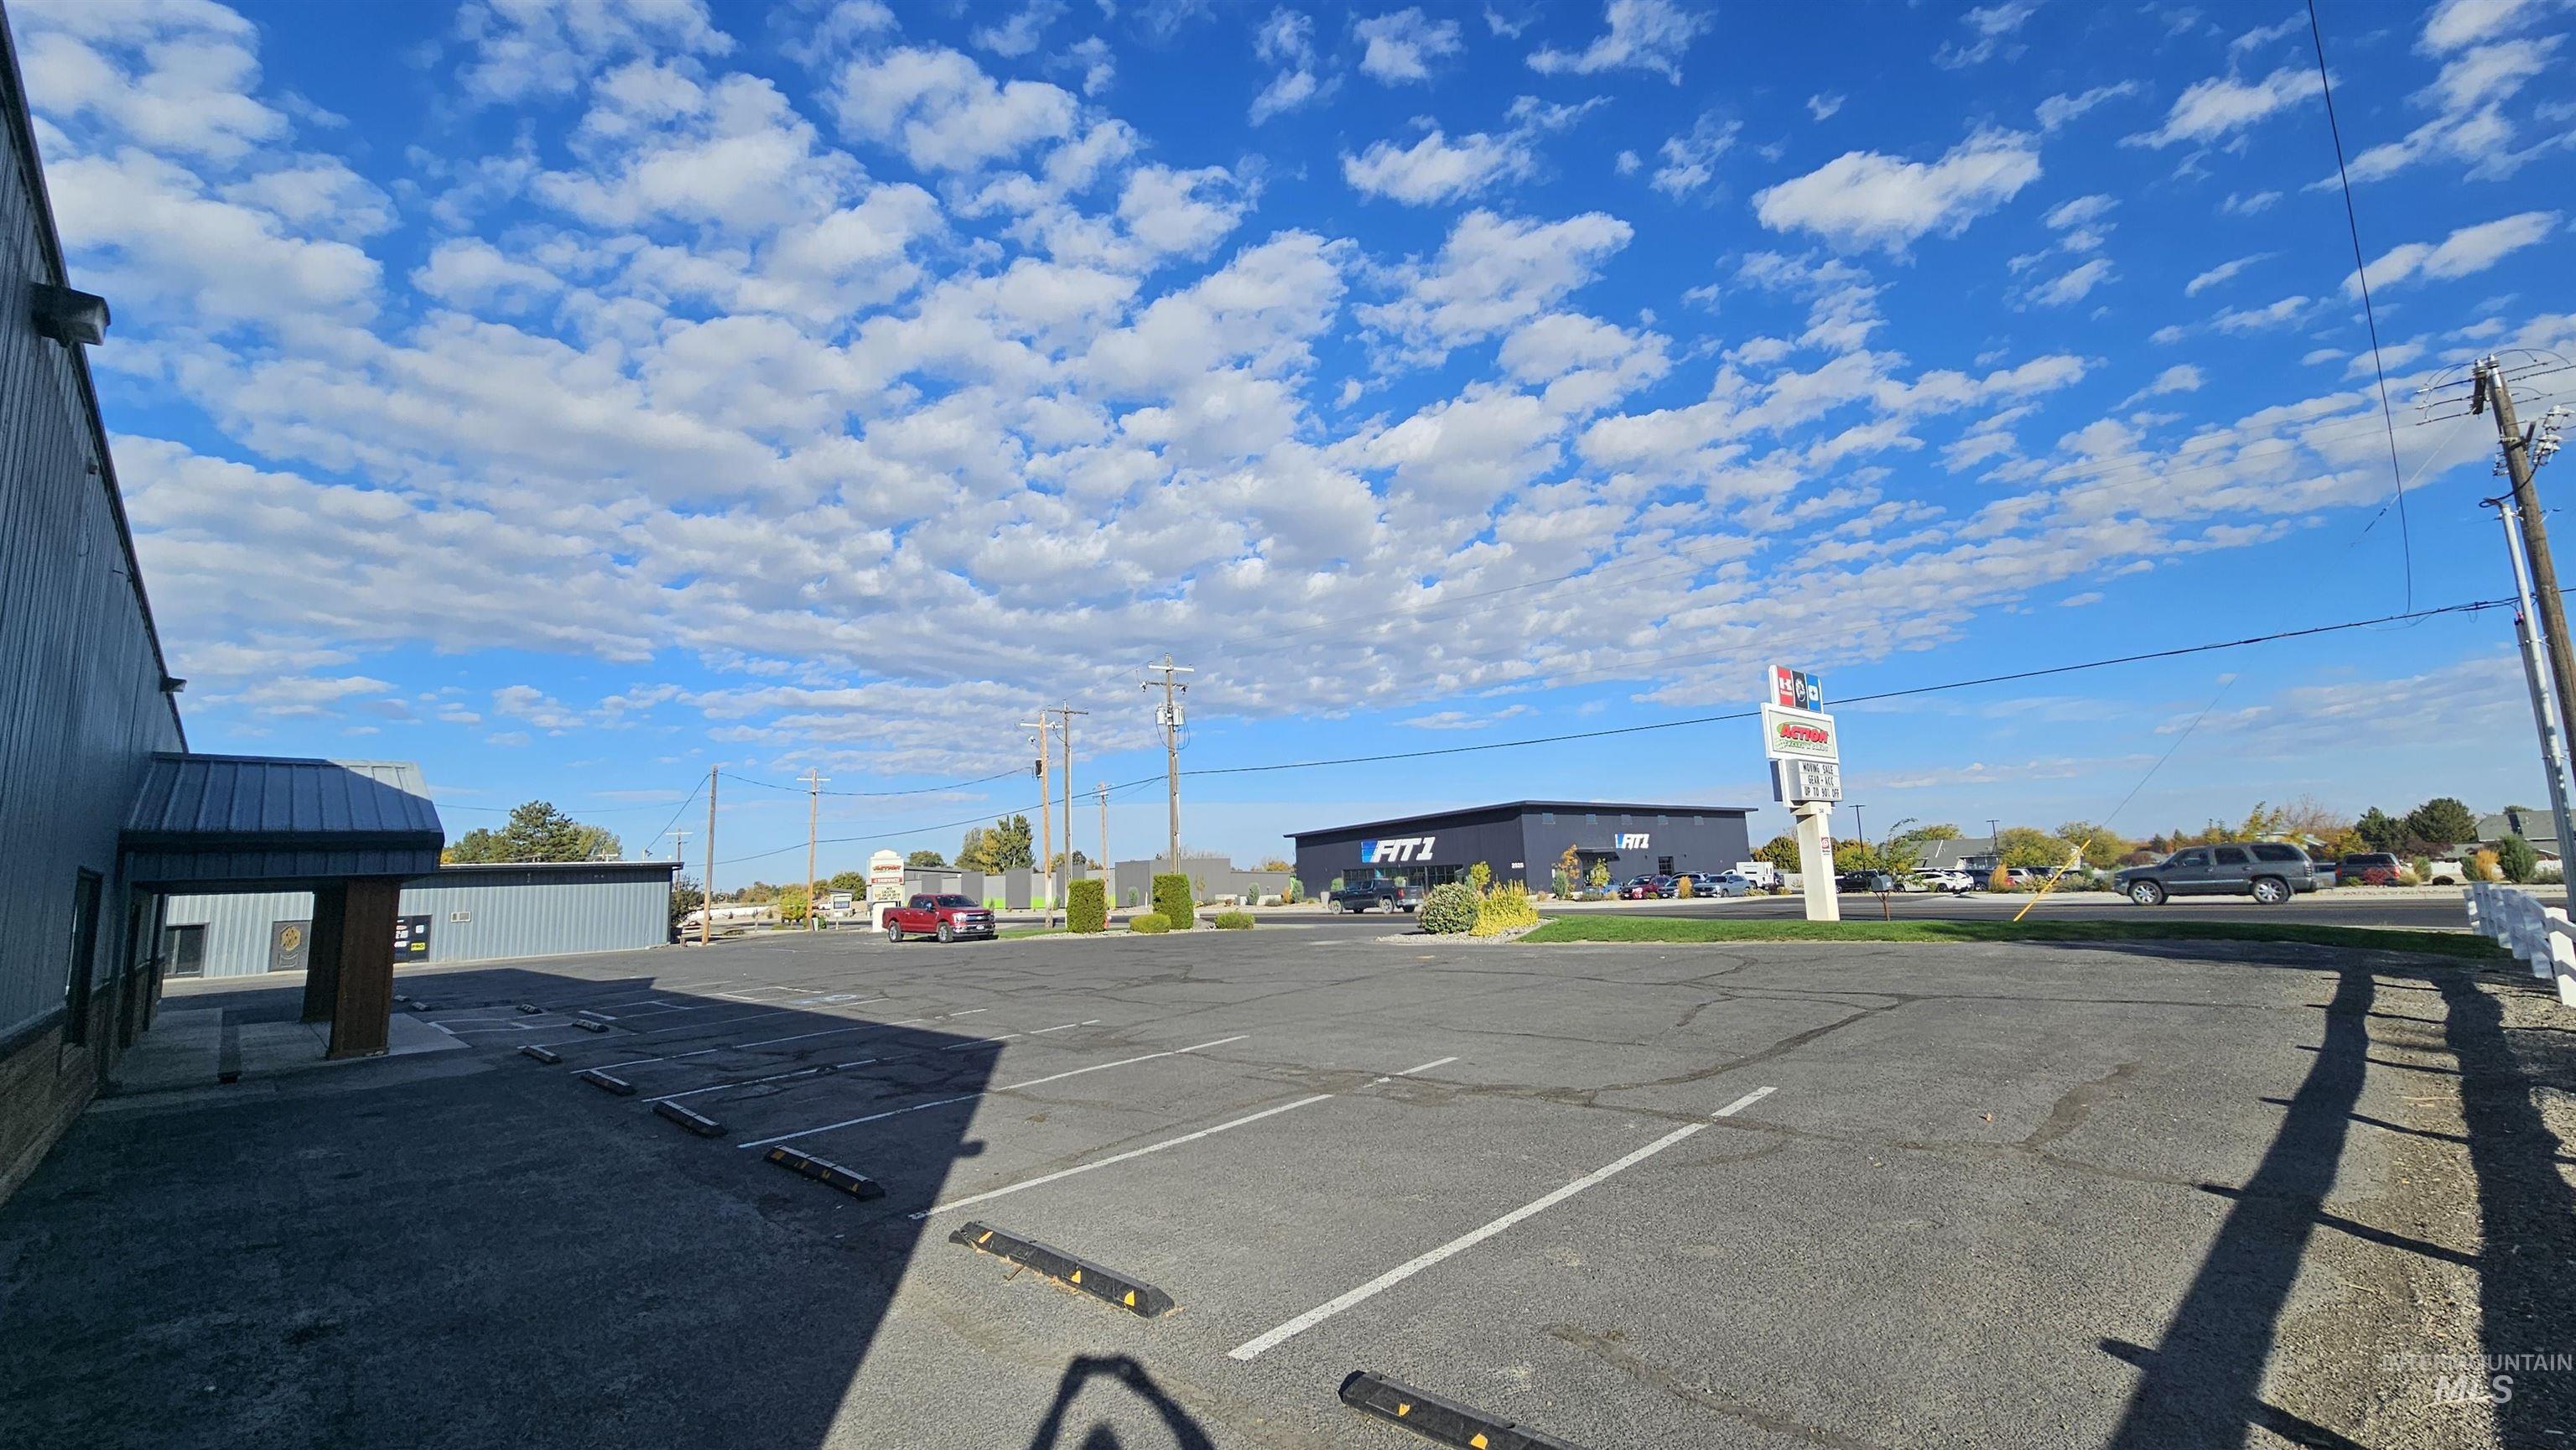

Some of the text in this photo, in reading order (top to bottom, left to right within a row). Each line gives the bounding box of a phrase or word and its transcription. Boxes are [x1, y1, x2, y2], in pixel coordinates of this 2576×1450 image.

[1780, 724, 1828, 744] ACTION
[1802, 762, 1834, 775] MOVING SALE
[1808, 775, 1820, 785] GEAR
[1825, 777, 1834, 787] ACC
[1805, 787, 1810, 796] UP
[1813, 787, 1819, 797] TO
